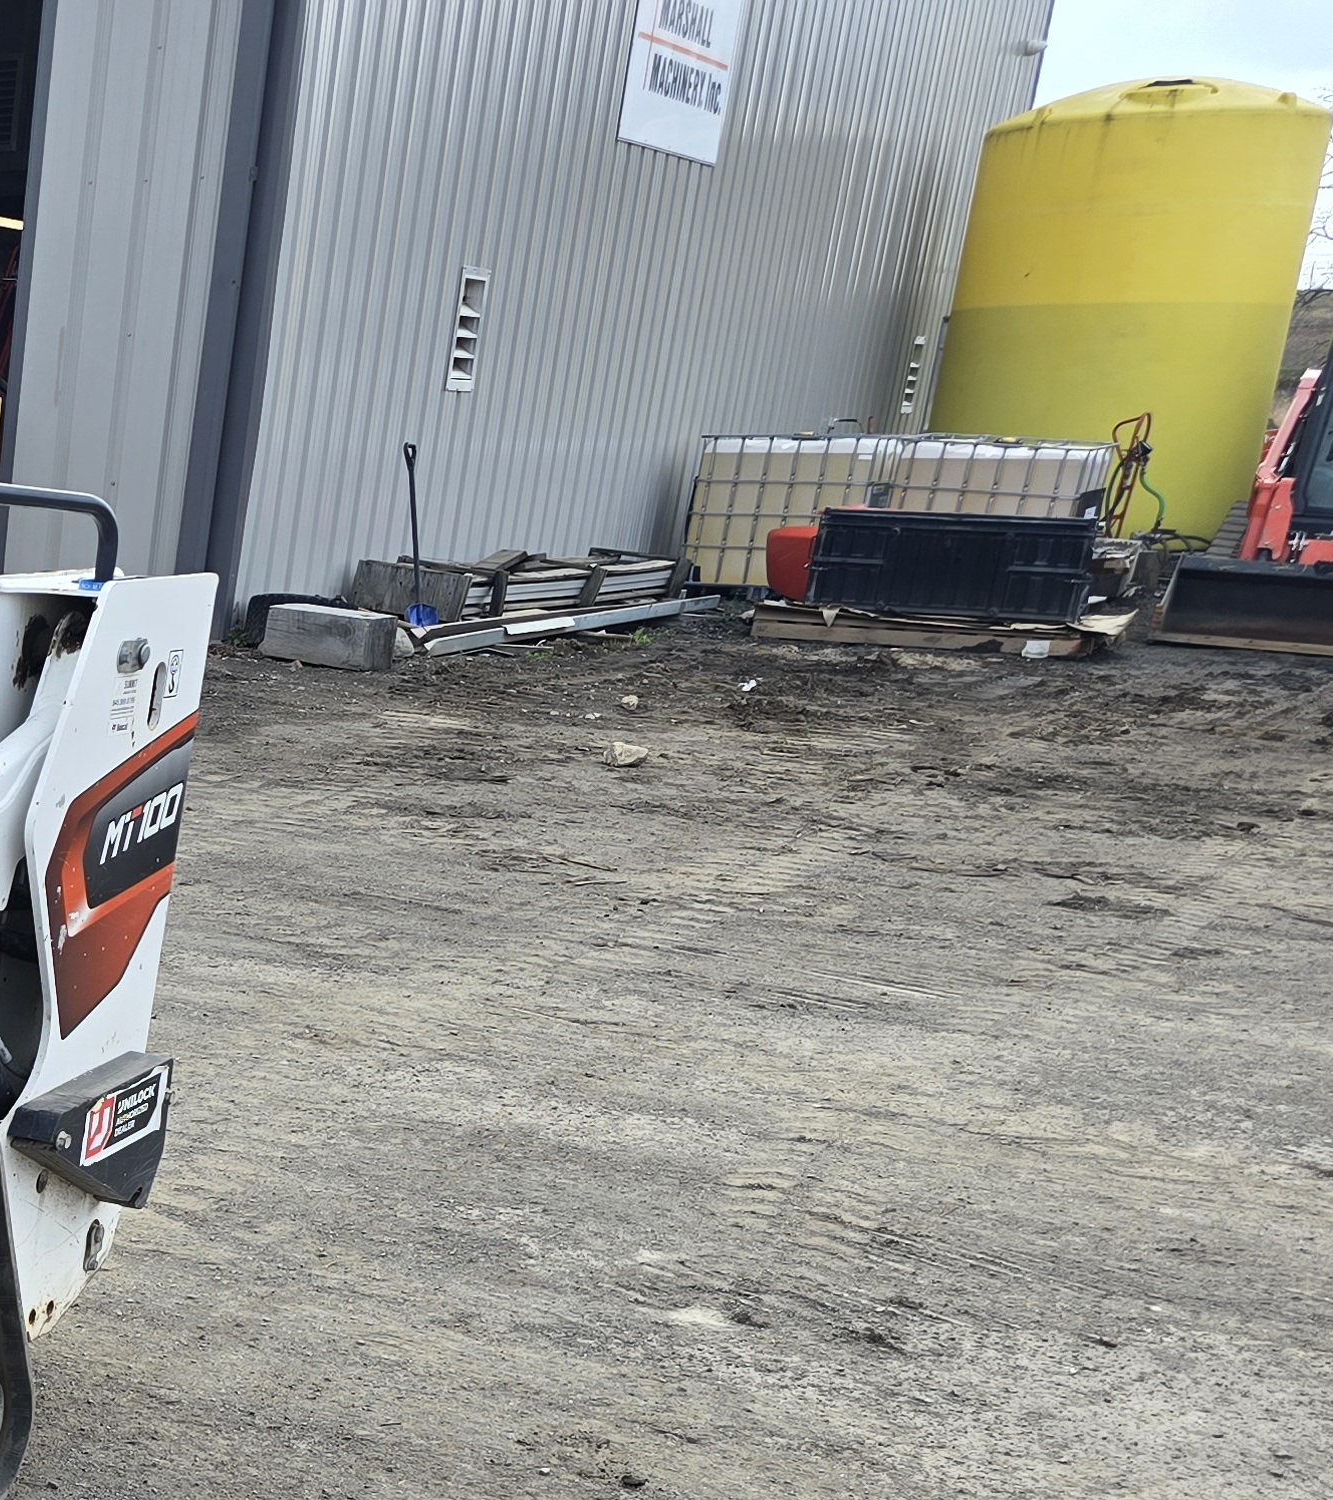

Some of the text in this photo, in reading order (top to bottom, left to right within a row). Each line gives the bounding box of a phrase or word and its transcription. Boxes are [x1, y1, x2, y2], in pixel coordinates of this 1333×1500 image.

[658, 0, 714, 48] MARSHALL
[99, 782, 184, 865] MT100
[117, 1084, 157, 1114] UNILOCK
[114, 1120, 136, 1137] DEALER
